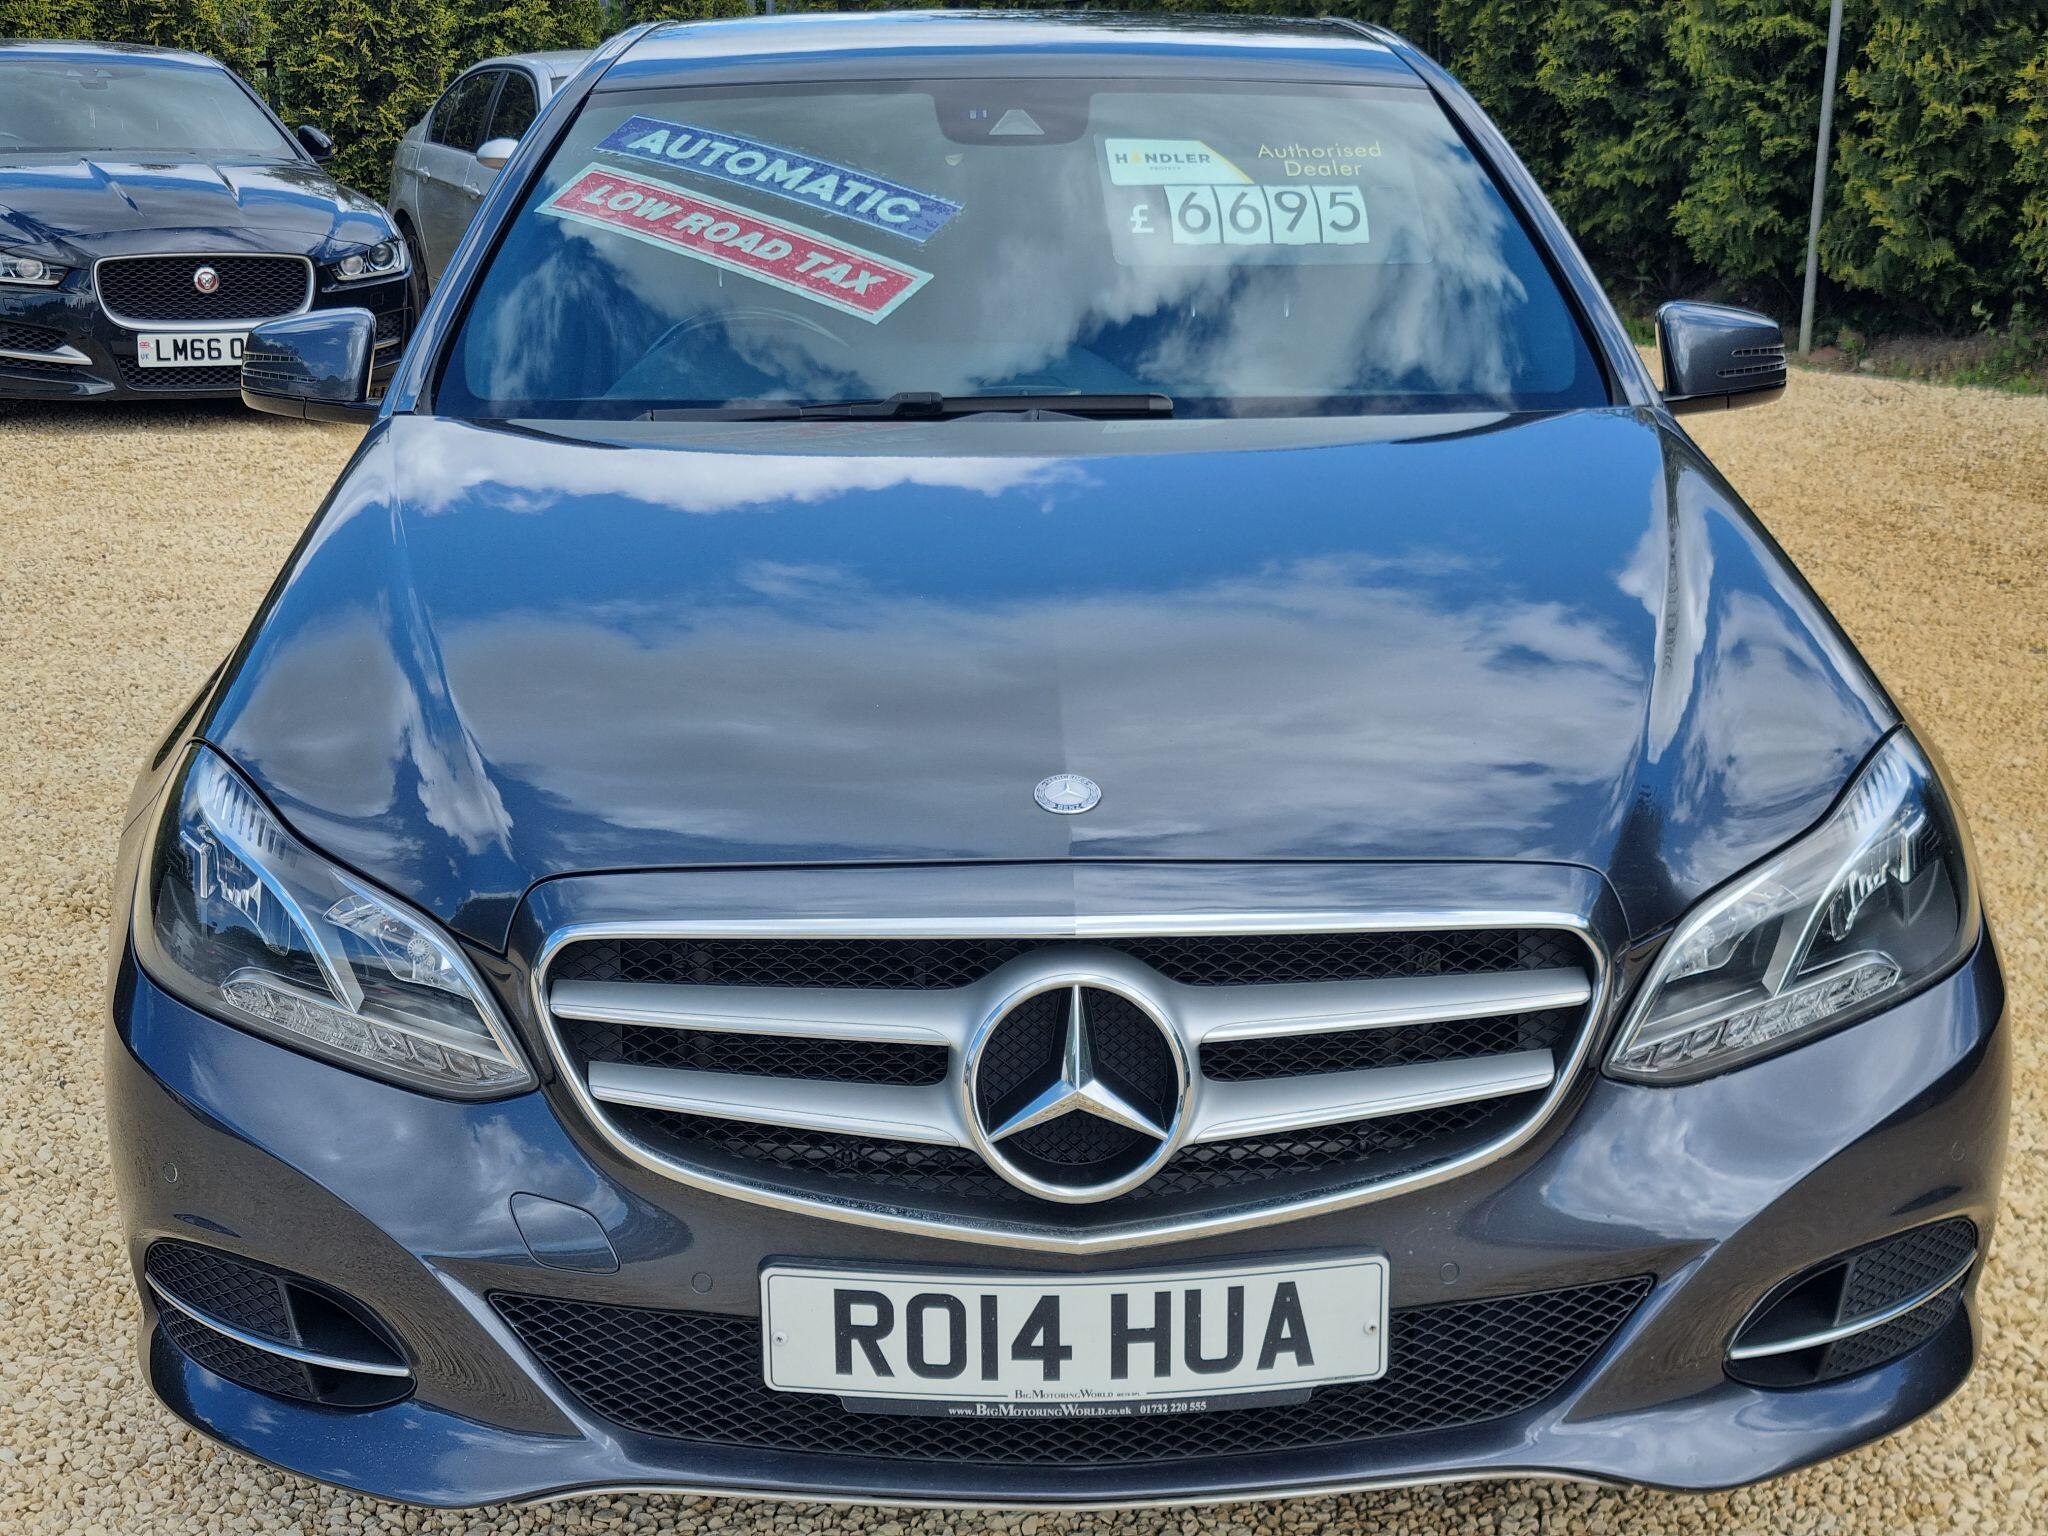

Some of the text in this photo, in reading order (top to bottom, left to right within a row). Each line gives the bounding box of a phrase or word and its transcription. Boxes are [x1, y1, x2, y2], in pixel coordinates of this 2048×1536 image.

[1258, 140, 1383, 158] Authorised
[626, 129, 921, 224] AUTOMATIC
[1284, 159, 1362, 176] Dealer
[1178, 191, 1361, 235] 6695
[582, 185, 887, 295] LOW ROAD TAX
[155, 338, 222, 361] LM66
[833, 1281, 1316, 1381] RO14 HUA
[1140, 1403, 1168, 1415] 01732
[1170, 1402, 1188, 1413] 220
[1189, 1401, 1207, 1412] 555
